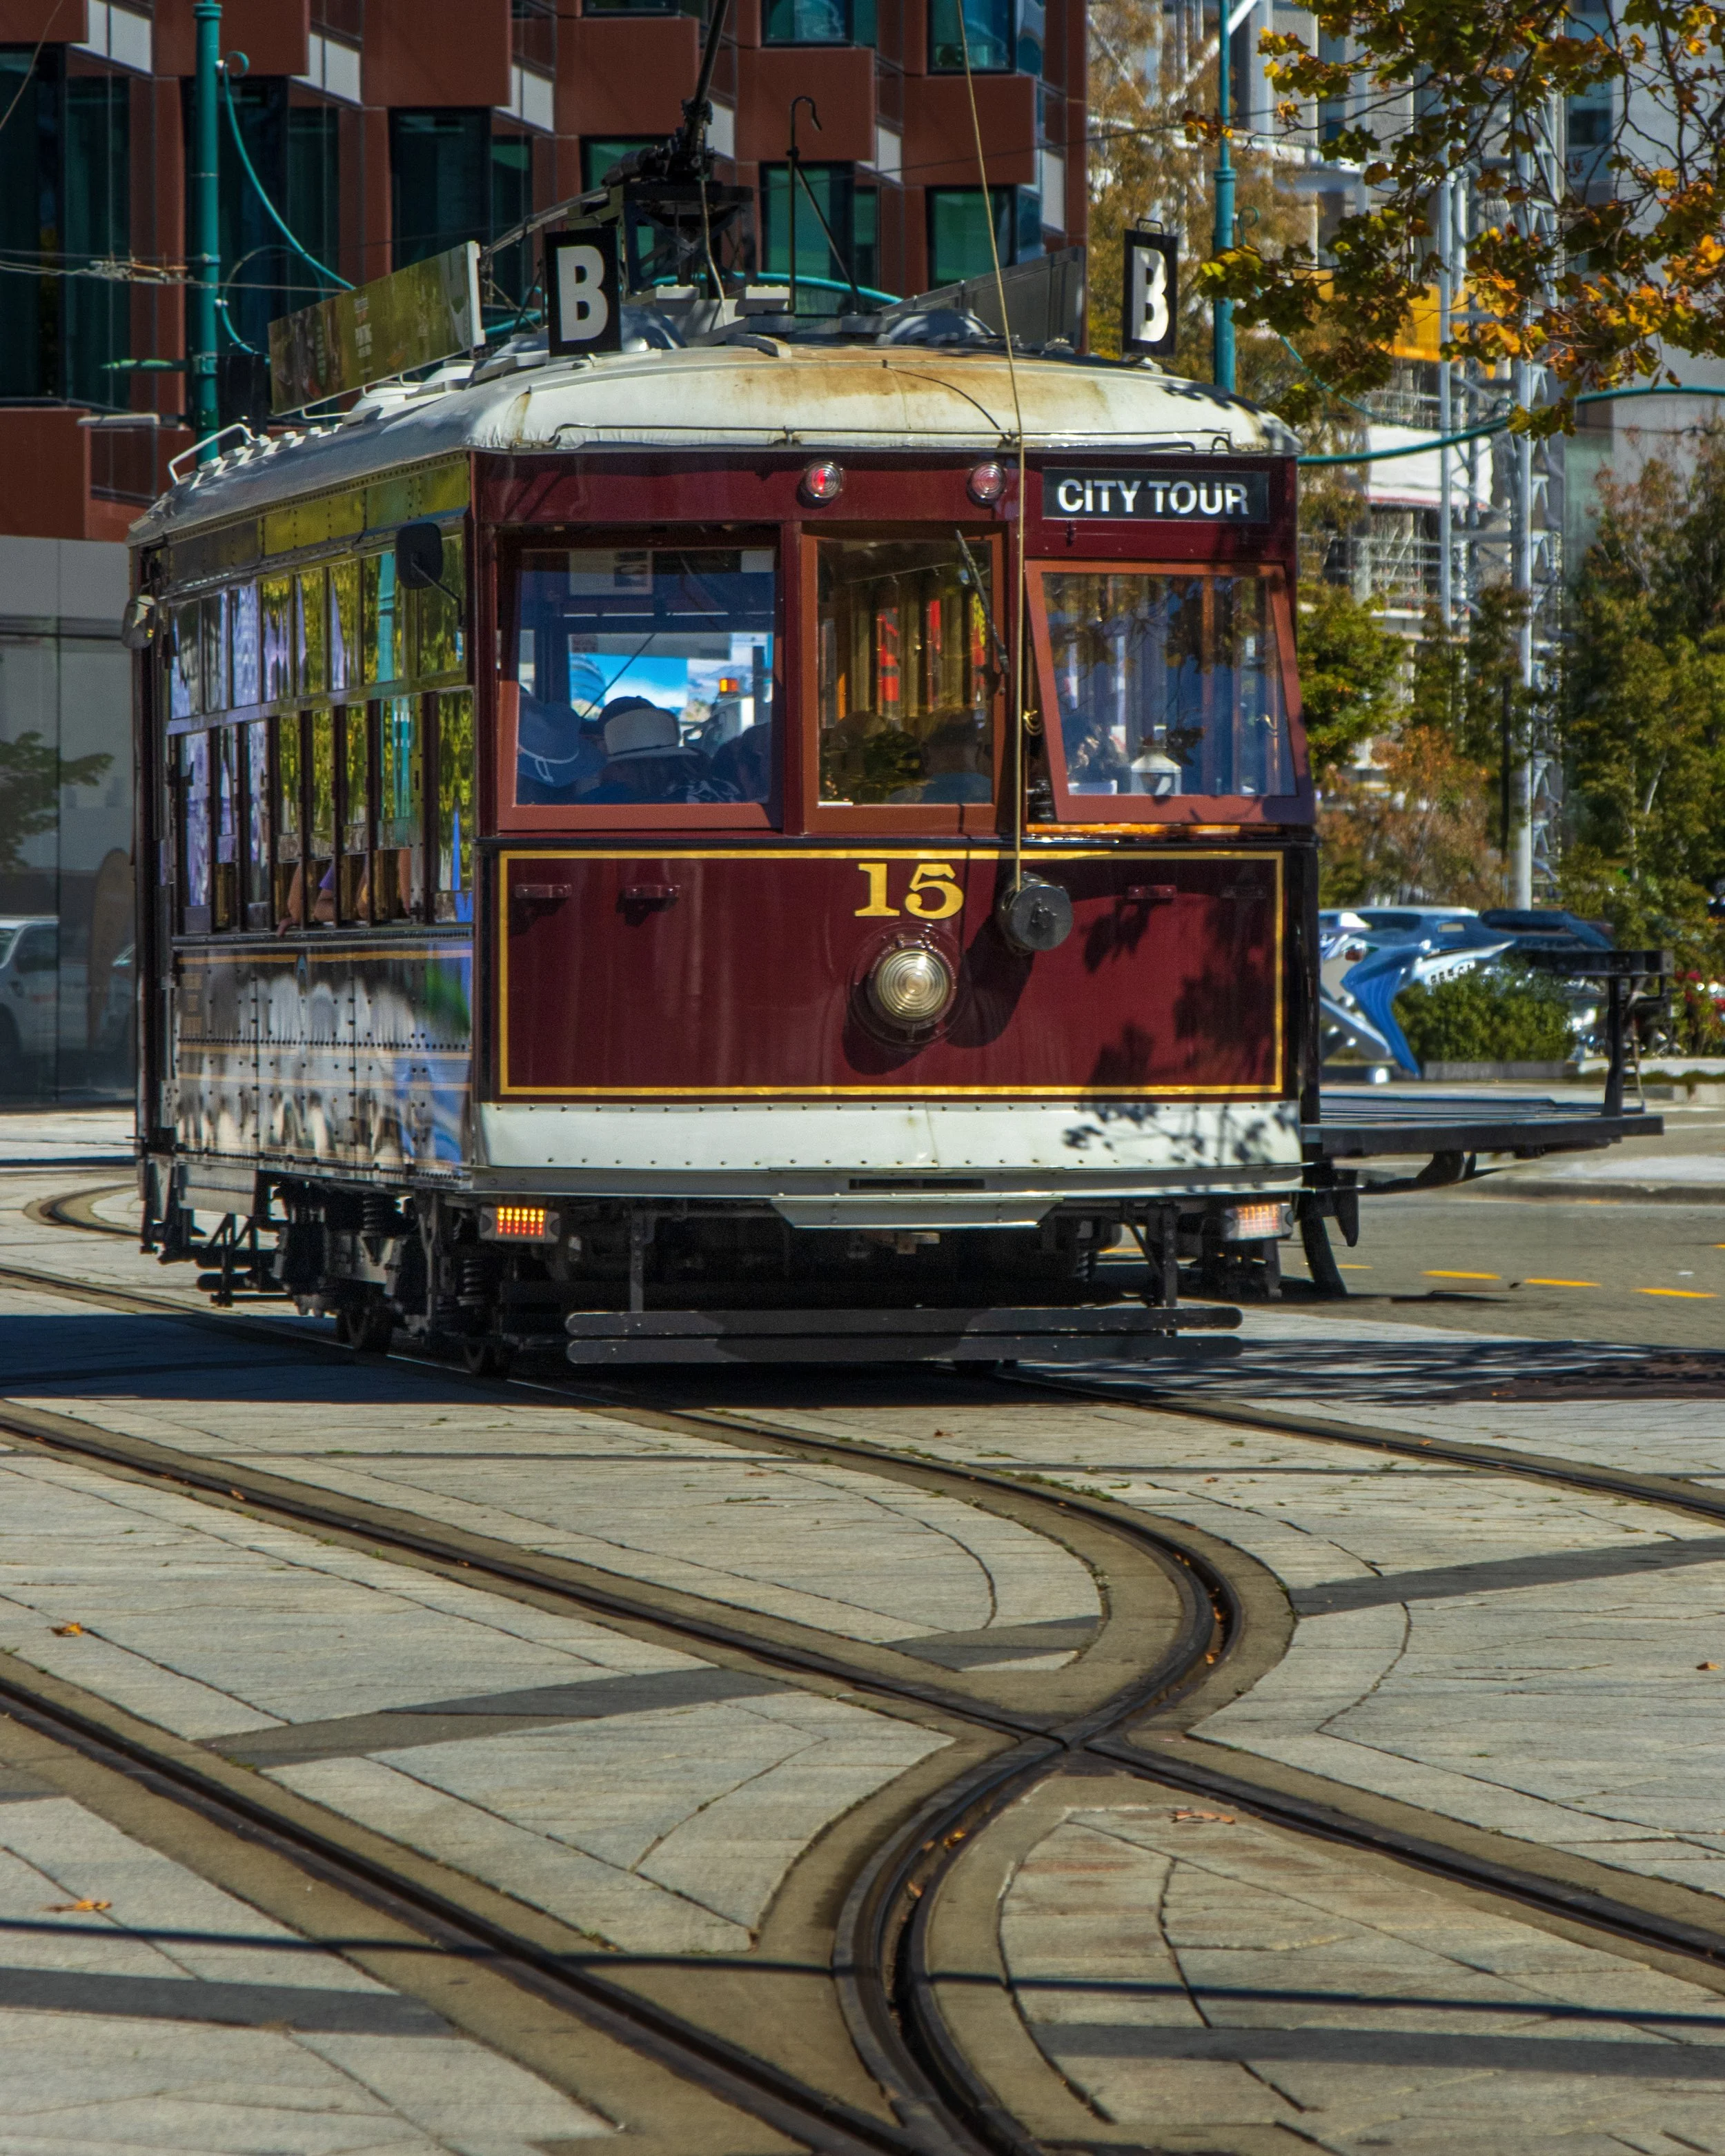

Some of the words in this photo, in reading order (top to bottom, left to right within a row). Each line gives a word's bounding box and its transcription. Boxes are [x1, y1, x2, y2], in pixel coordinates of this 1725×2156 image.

[557, 245, 609, 342] B
[1131, 246, 1170, 343] B
[1057, 479, 1142, 513] CITY
[1148, 480, 1250, 515] TOUR
[854, 863, 965, 920] 15
